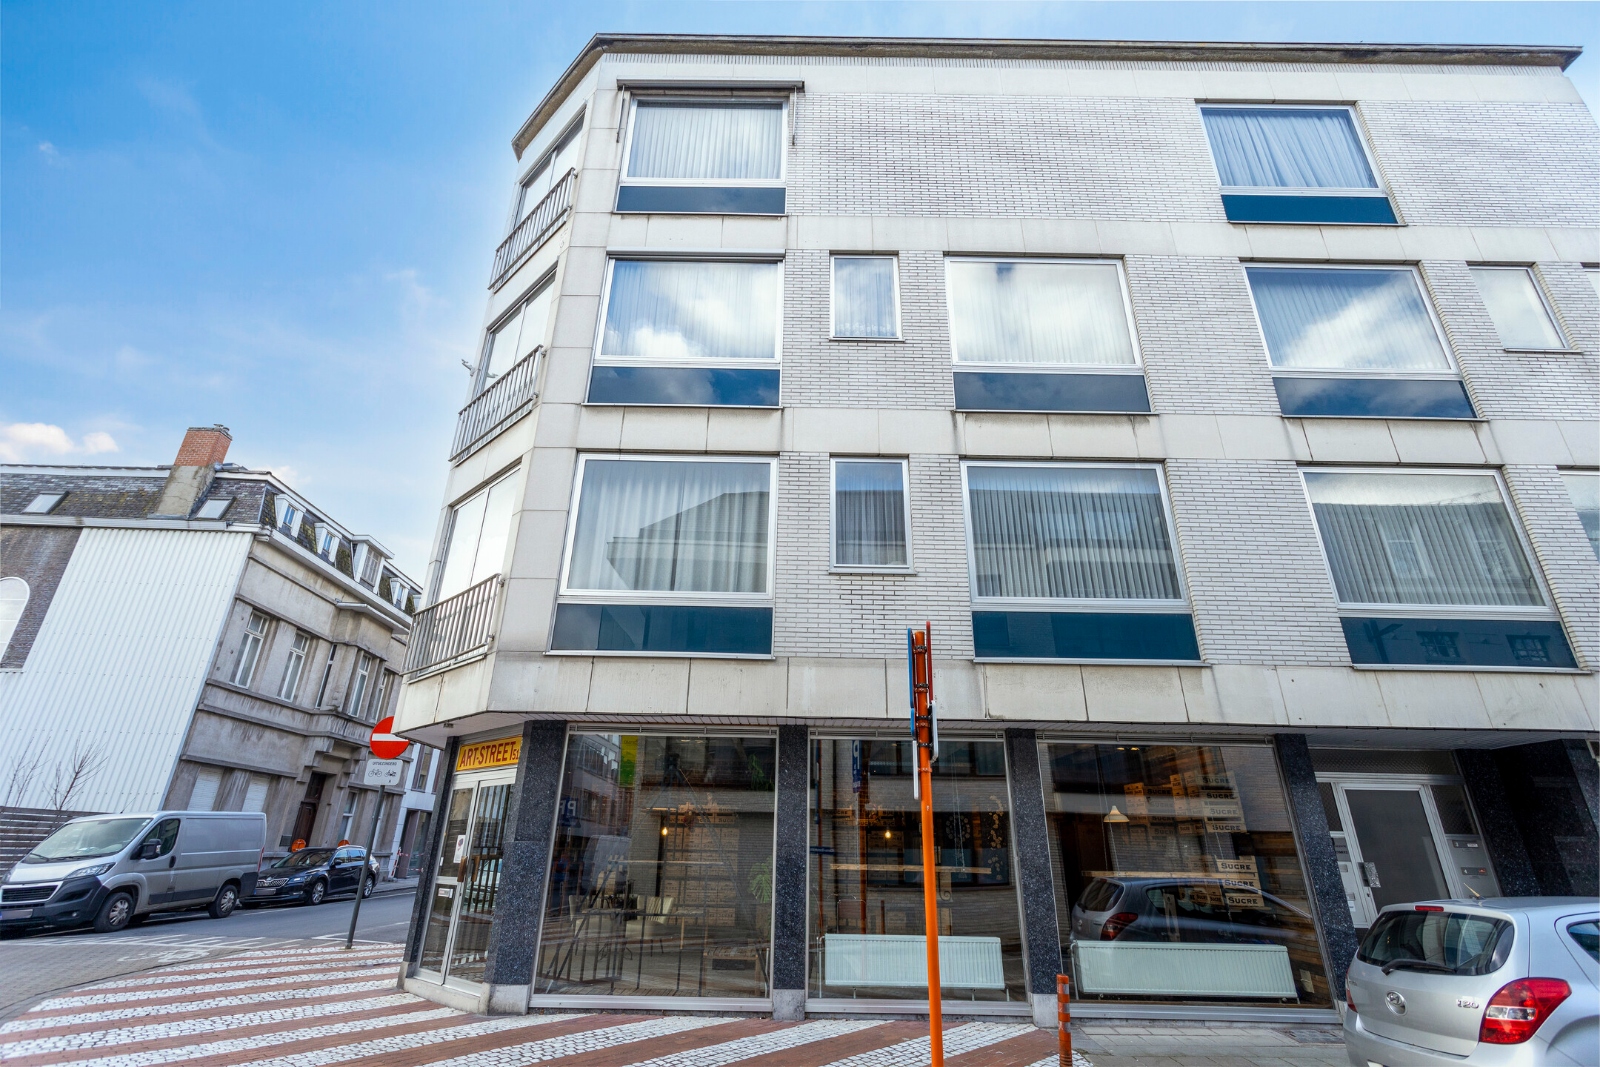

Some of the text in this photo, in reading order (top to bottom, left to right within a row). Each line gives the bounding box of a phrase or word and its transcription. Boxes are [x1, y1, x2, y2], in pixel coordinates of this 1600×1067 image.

[459, 741, 516, 768] ART-STREET
[1202, 776, 1230, 784] SUCRE
[1206, 792, 1235, 800] SUCRE
[1221, 862, 1251, 870] SUCRE
[1228, 896, 1258, 905] SUCRE
